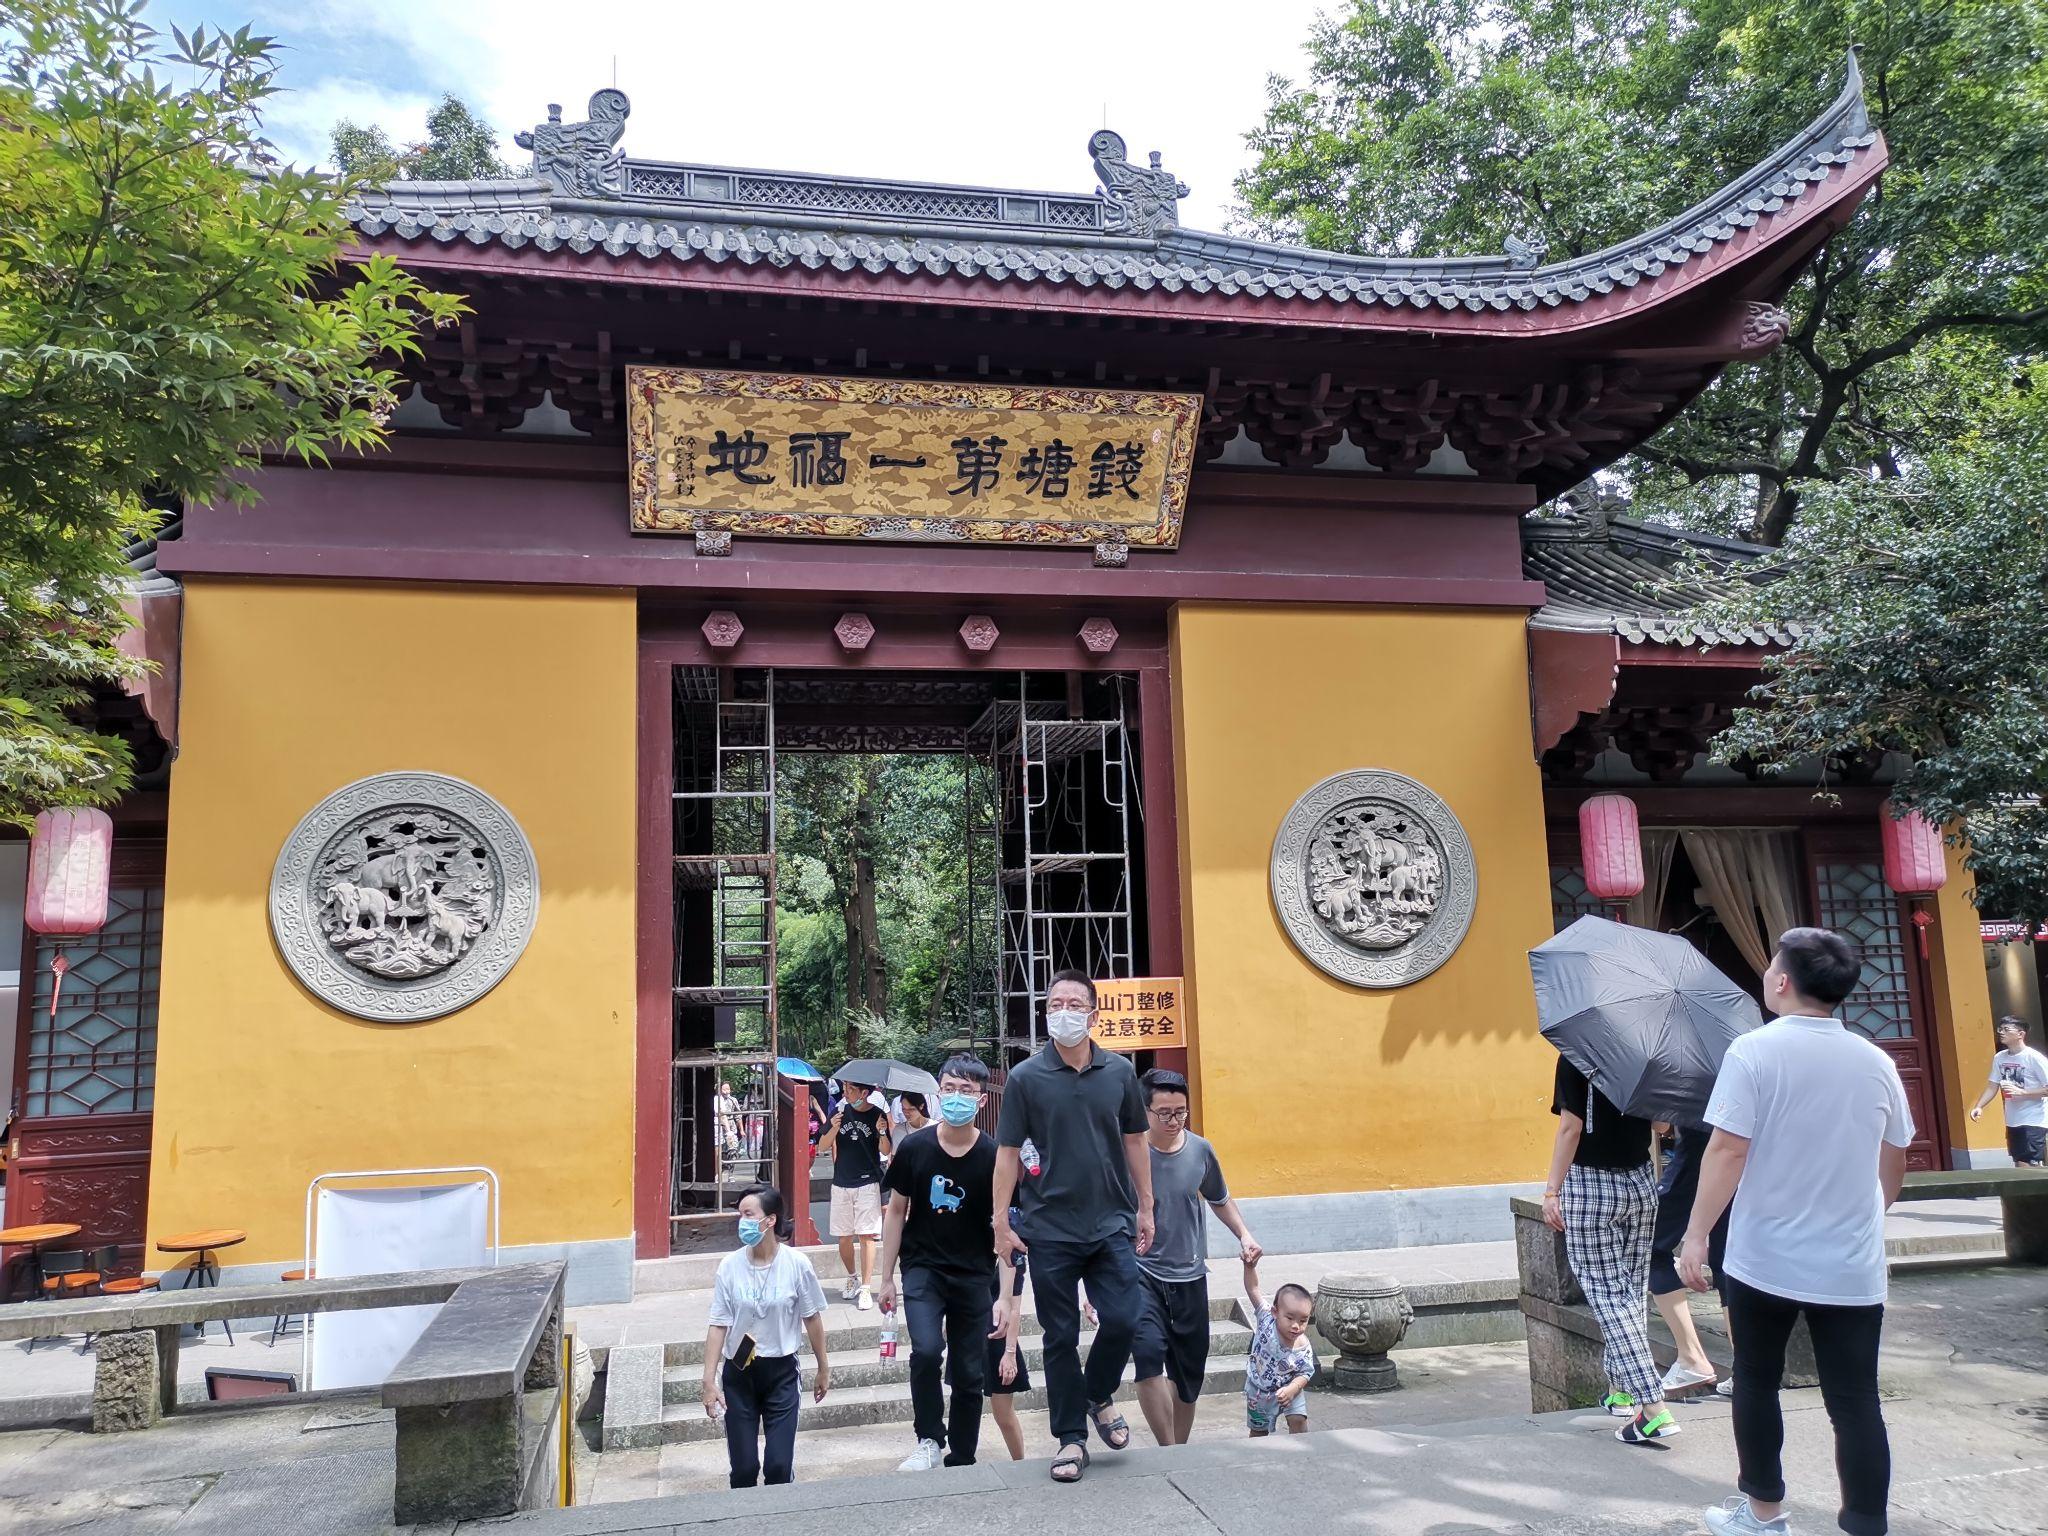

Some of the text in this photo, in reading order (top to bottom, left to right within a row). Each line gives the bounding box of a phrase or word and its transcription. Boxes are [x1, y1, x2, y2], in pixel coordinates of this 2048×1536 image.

[1098, 991, 1175, 1012] 山门整修
[1099, 1015, 1175, 1037] 注意安全
